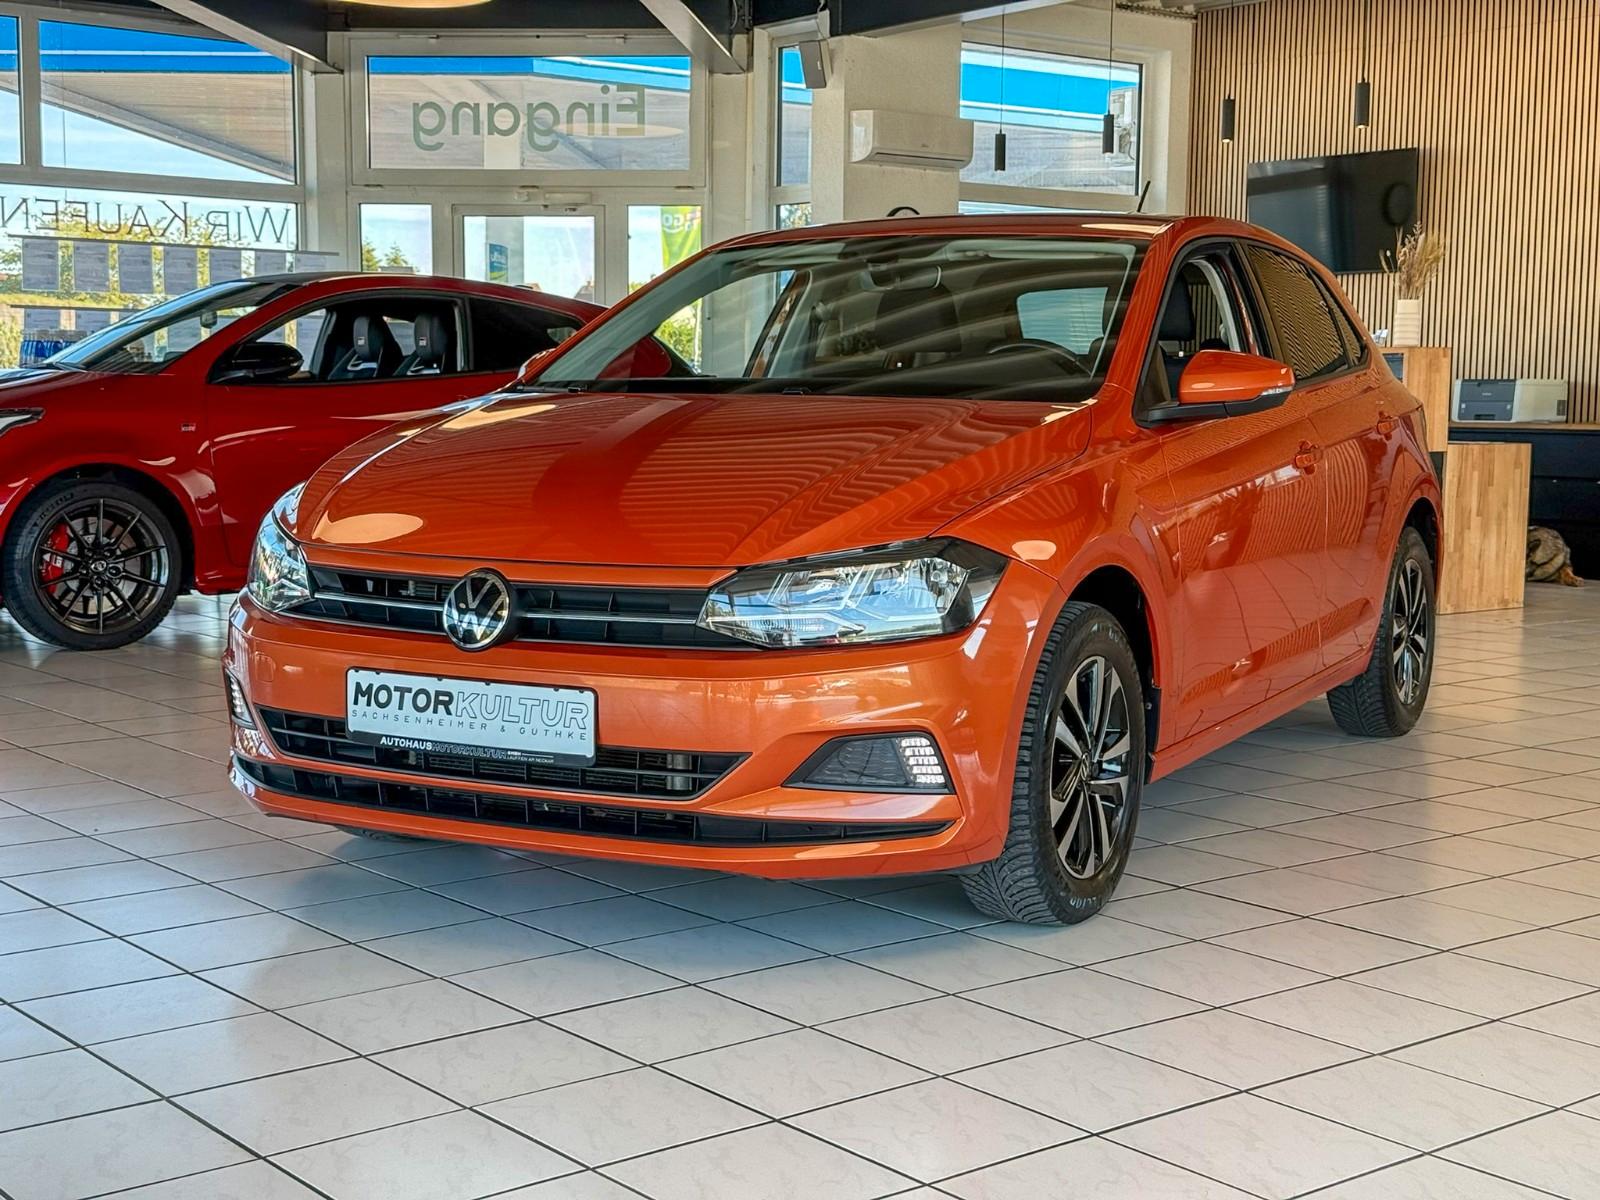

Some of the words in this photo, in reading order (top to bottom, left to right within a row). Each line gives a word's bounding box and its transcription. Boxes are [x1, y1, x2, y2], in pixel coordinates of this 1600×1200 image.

[351, 709, 488, 731] SACHSENHEIMER
[500, 725, 506, 733] &
[519, 726, 587, 741] GUTHKE
